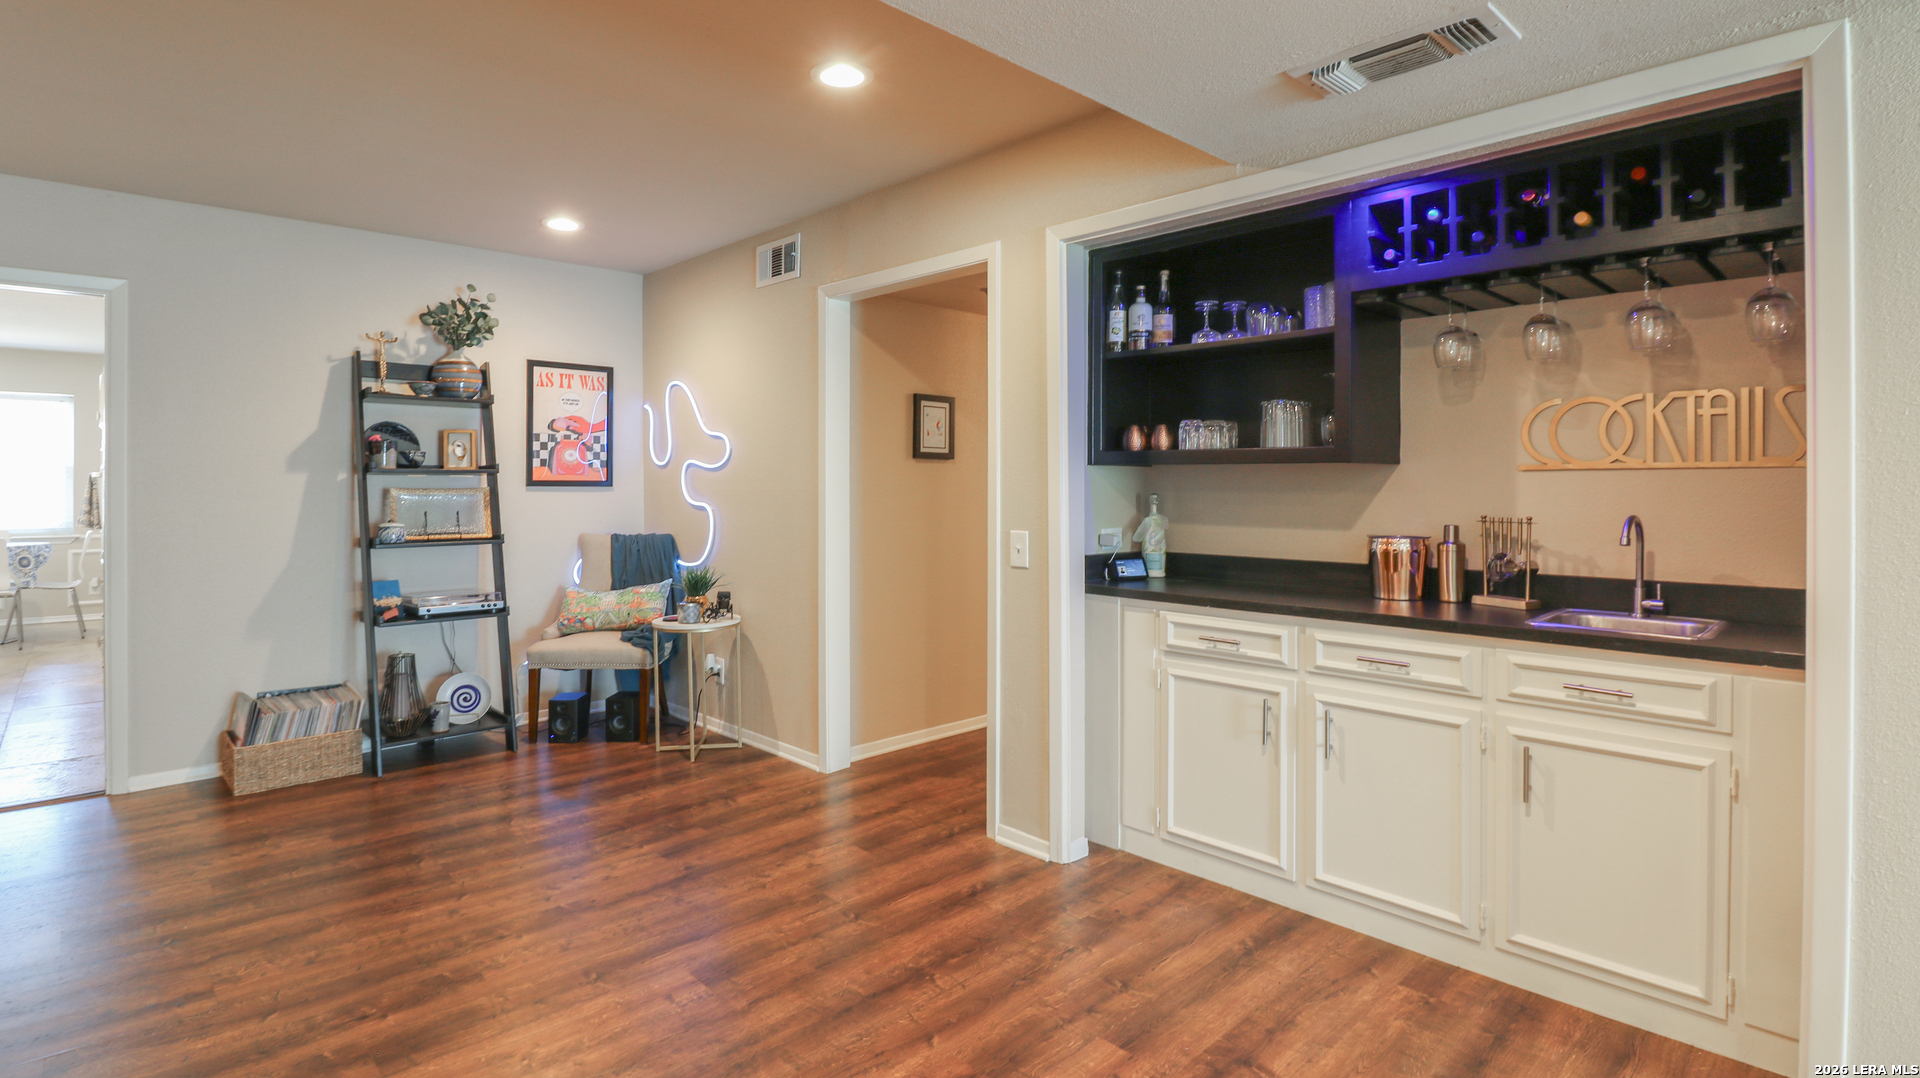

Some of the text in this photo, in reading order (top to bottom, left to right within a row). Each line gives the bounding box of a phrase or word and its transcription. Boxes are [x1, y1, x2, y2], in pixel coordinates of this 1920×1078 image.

[536, 371, 605, 391] AS IT WAS
[1519, 385, 1807, 468] COCKTAILS
